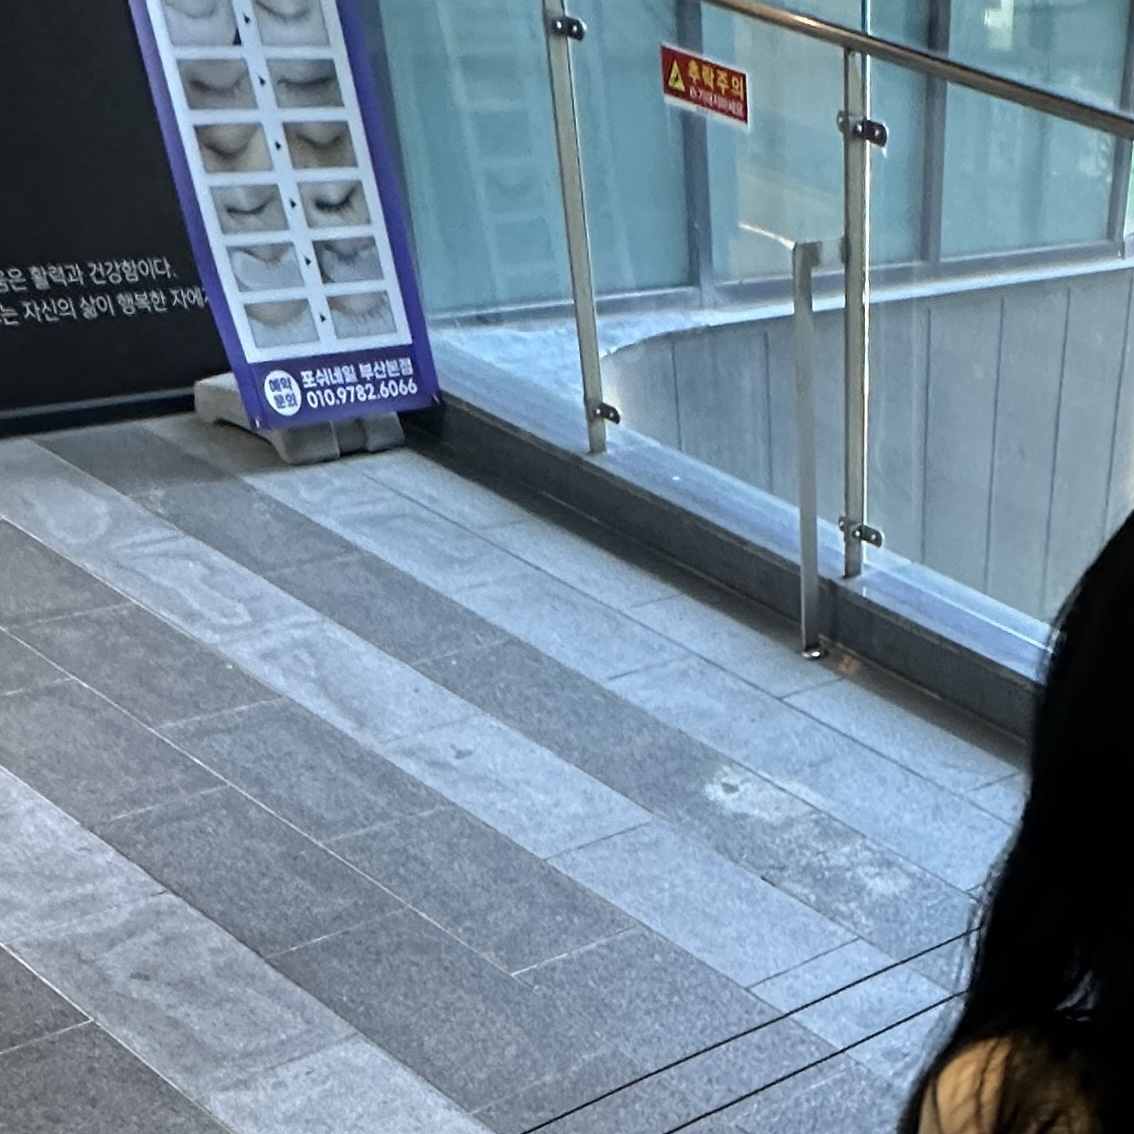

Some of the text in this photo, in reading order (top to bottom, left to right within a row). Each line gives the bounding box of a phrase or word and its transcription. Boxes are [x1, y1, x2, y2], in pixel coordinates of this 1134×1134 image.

[688, 60, 744, 101] 추락주의
[29, 263, 84, 291] 활력과
[87, 256, 180, 285] 건강함이다.
[22, 297, 78, 323] 자신의
[80, 293, 115, 320] 삶이
[116, 289, 167, 315] 행복한
[169, 285, 209, 311] 자에
[268, 377, 293, 393] 예약
[300, 357, 414, 389] 포쉬네일 부산본점
[273, 393, 298, 409] 문의
[307, 378, 418, 409] 010.9782.6066
